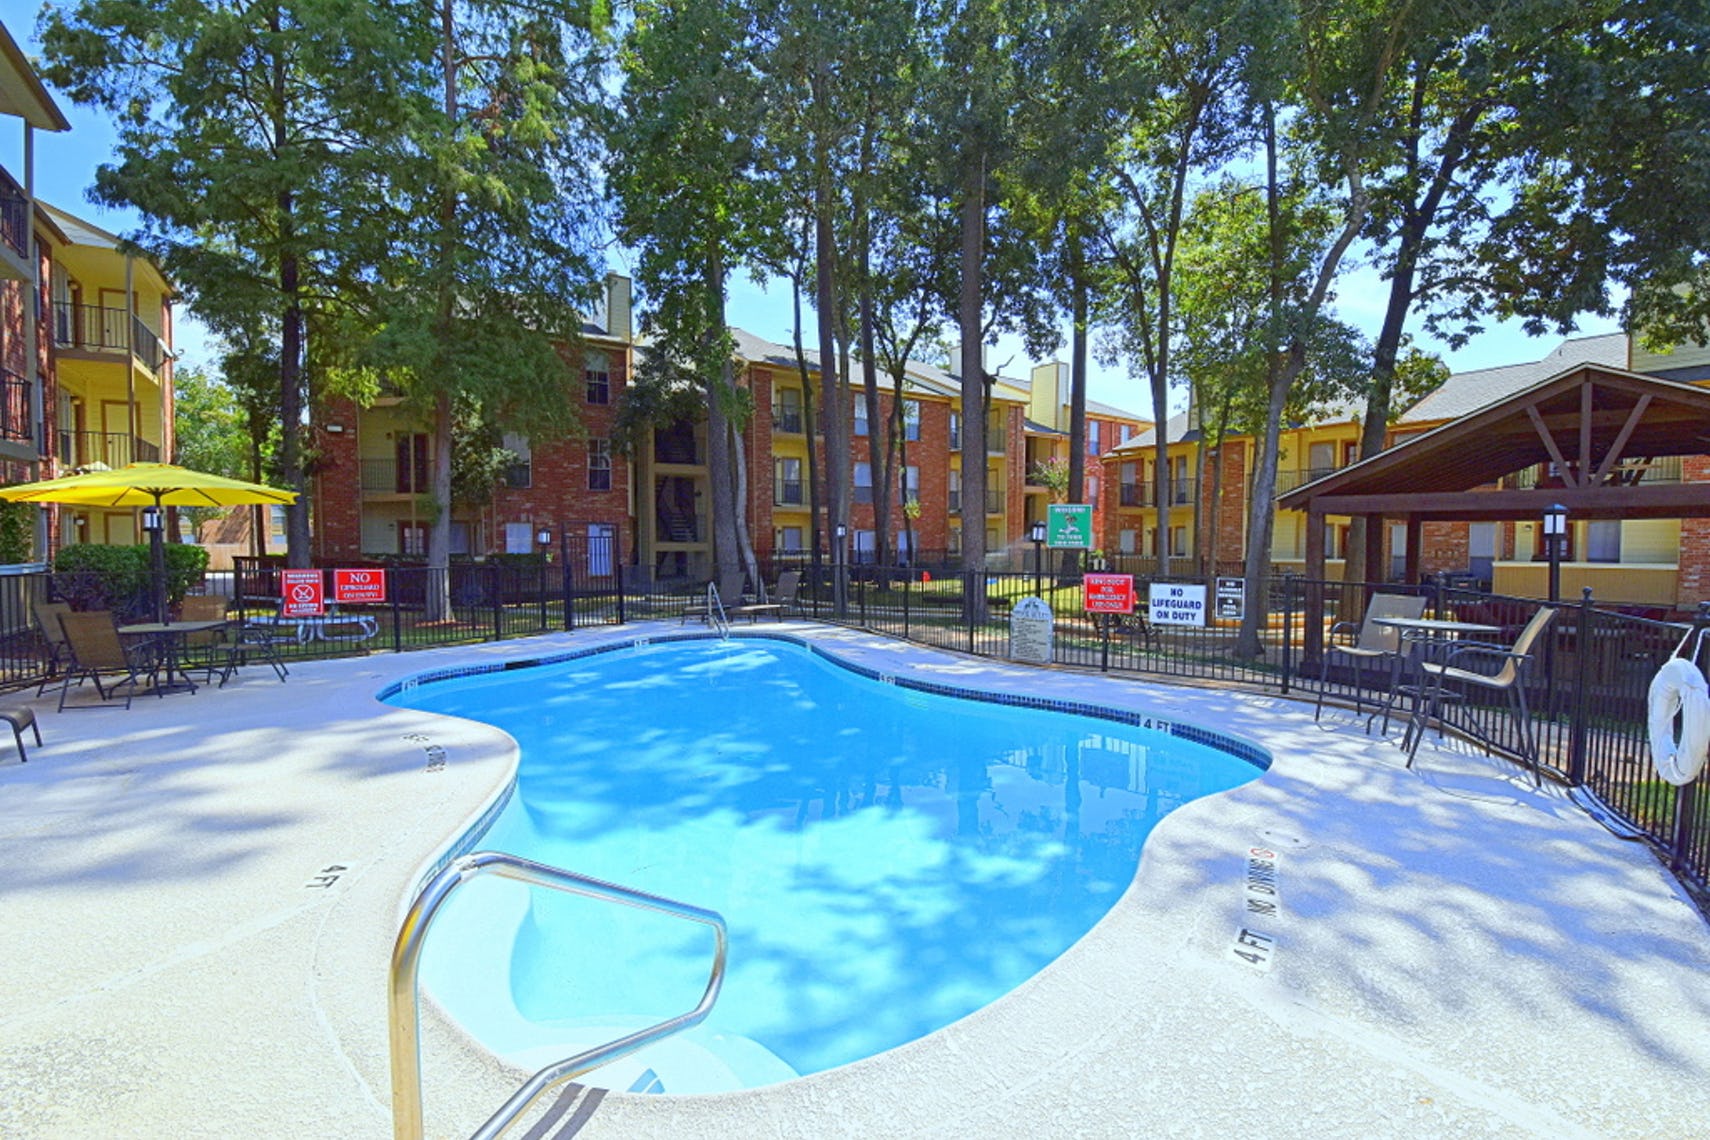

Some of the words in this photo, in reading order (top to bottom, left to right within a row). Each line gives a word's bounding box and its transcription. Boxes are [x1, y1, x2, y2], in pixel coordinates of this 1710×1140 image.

[350, 572, 371, 583] NO
[1170, 588, 1183, 597] NO
[1152, 598, 1202, 610] LIFEGUARD
[1156, 610, 1169, 619] ON
[1172, 611, 1196, 621] DUTY
[1143, 718, 1152, 729] 4
[1157, 720, 1170, 732] FT
[305, 875, 341, 888] FT
[1248, 858, 1276, 895] DIVING
[1247, 898, 1277, 918] NO
[1238, 929, 1273, 951] FT
[1233, 949, 1266, 964] 4
